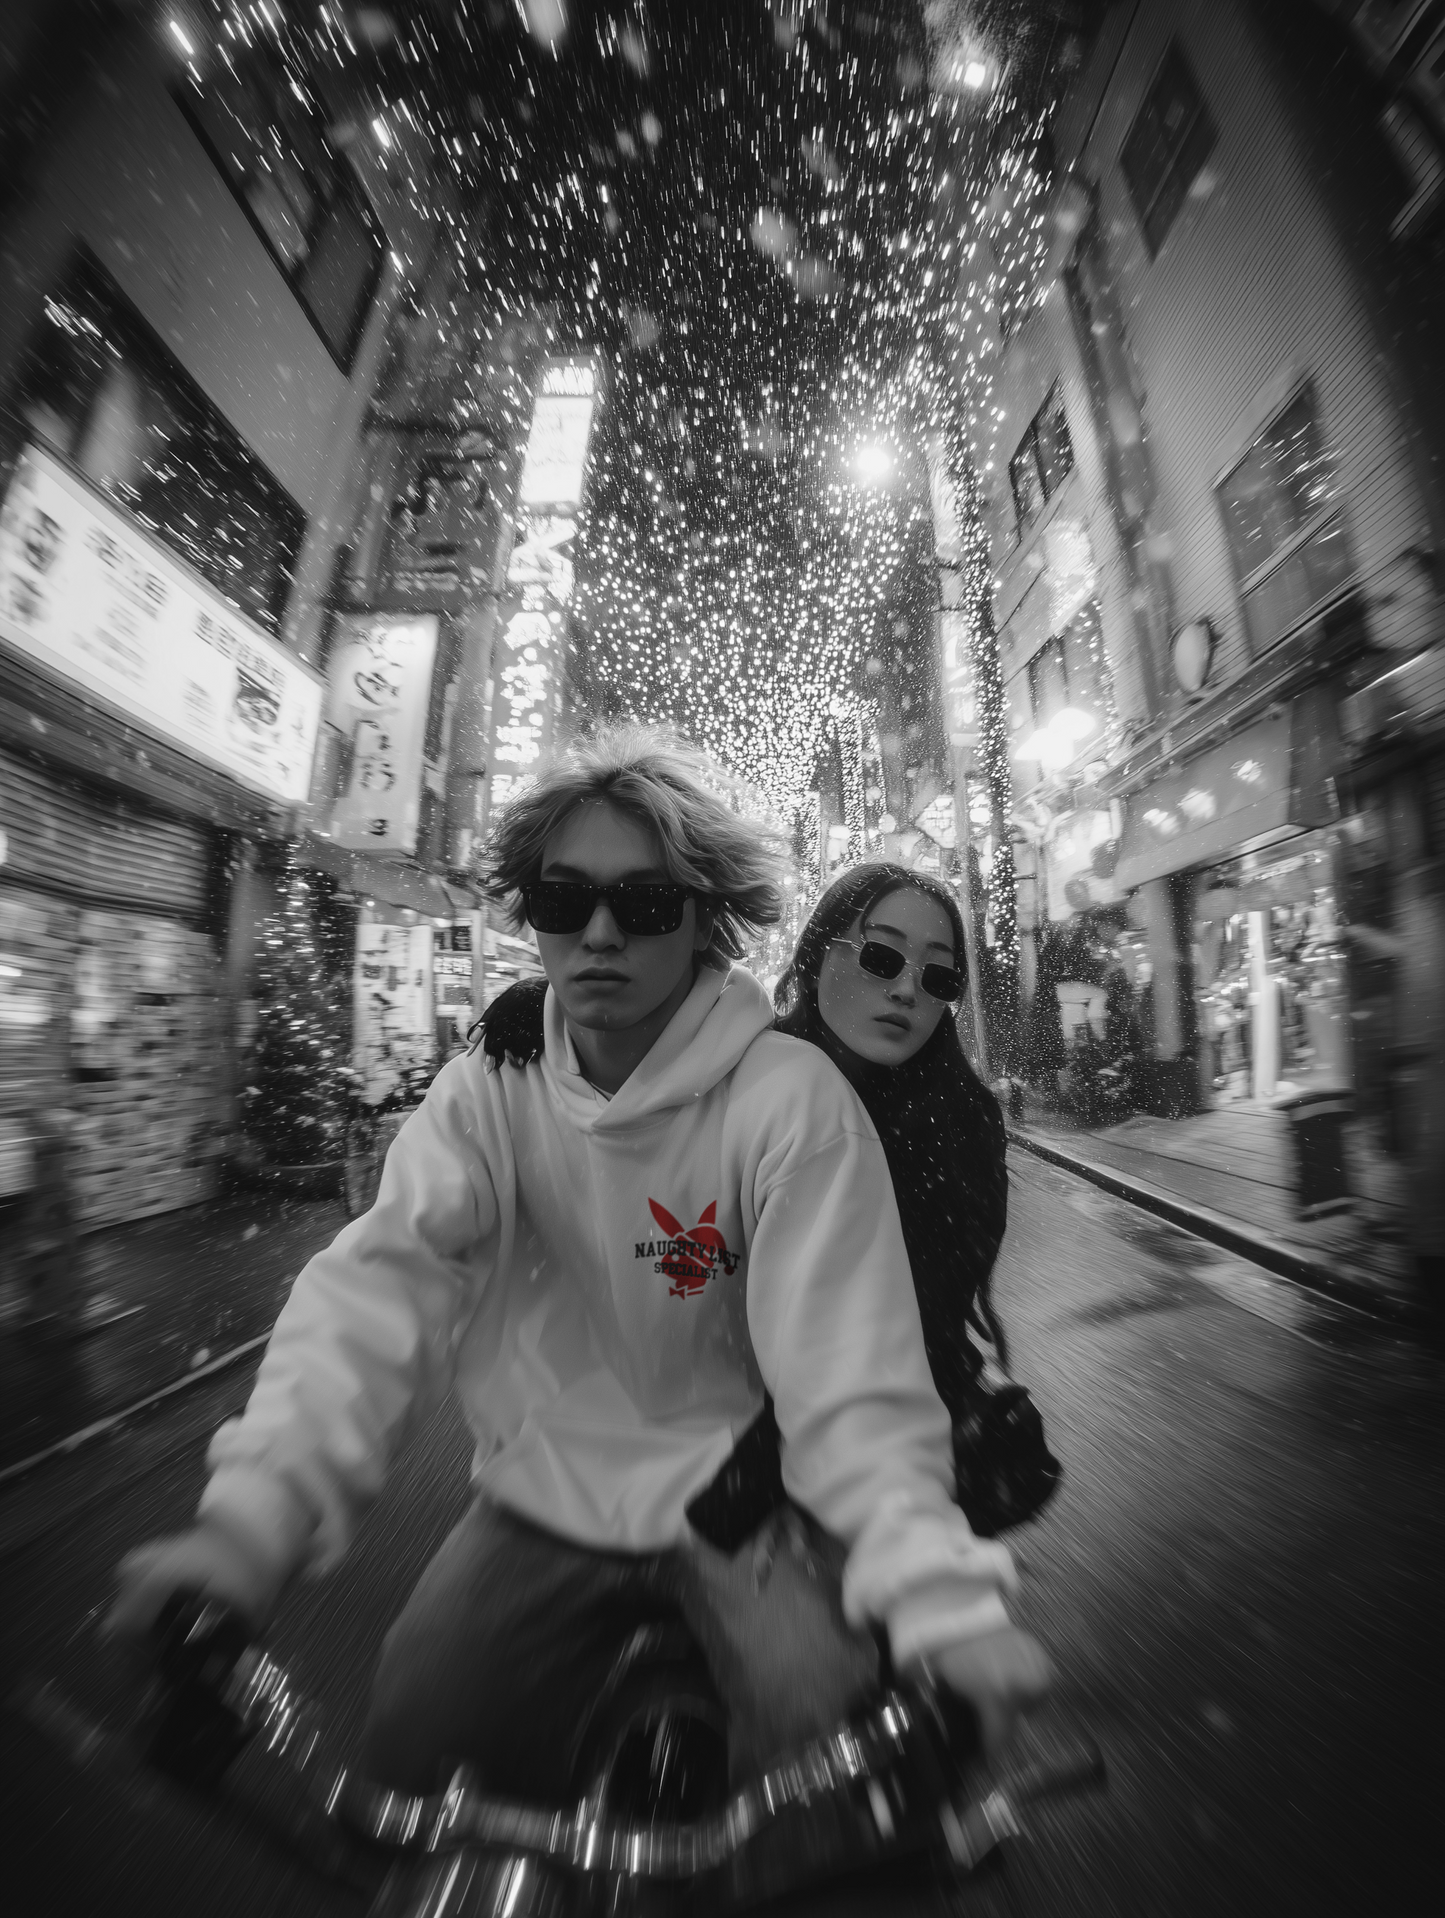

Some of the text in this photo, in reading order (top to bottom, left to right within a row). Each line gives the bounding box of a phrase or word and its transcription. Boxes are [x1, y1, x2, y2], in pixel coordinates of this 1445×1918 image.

[634, 1240, 741, 1269] NAUGHTY LIST
[654, 1262, 718, 1280] SPECIALIST
